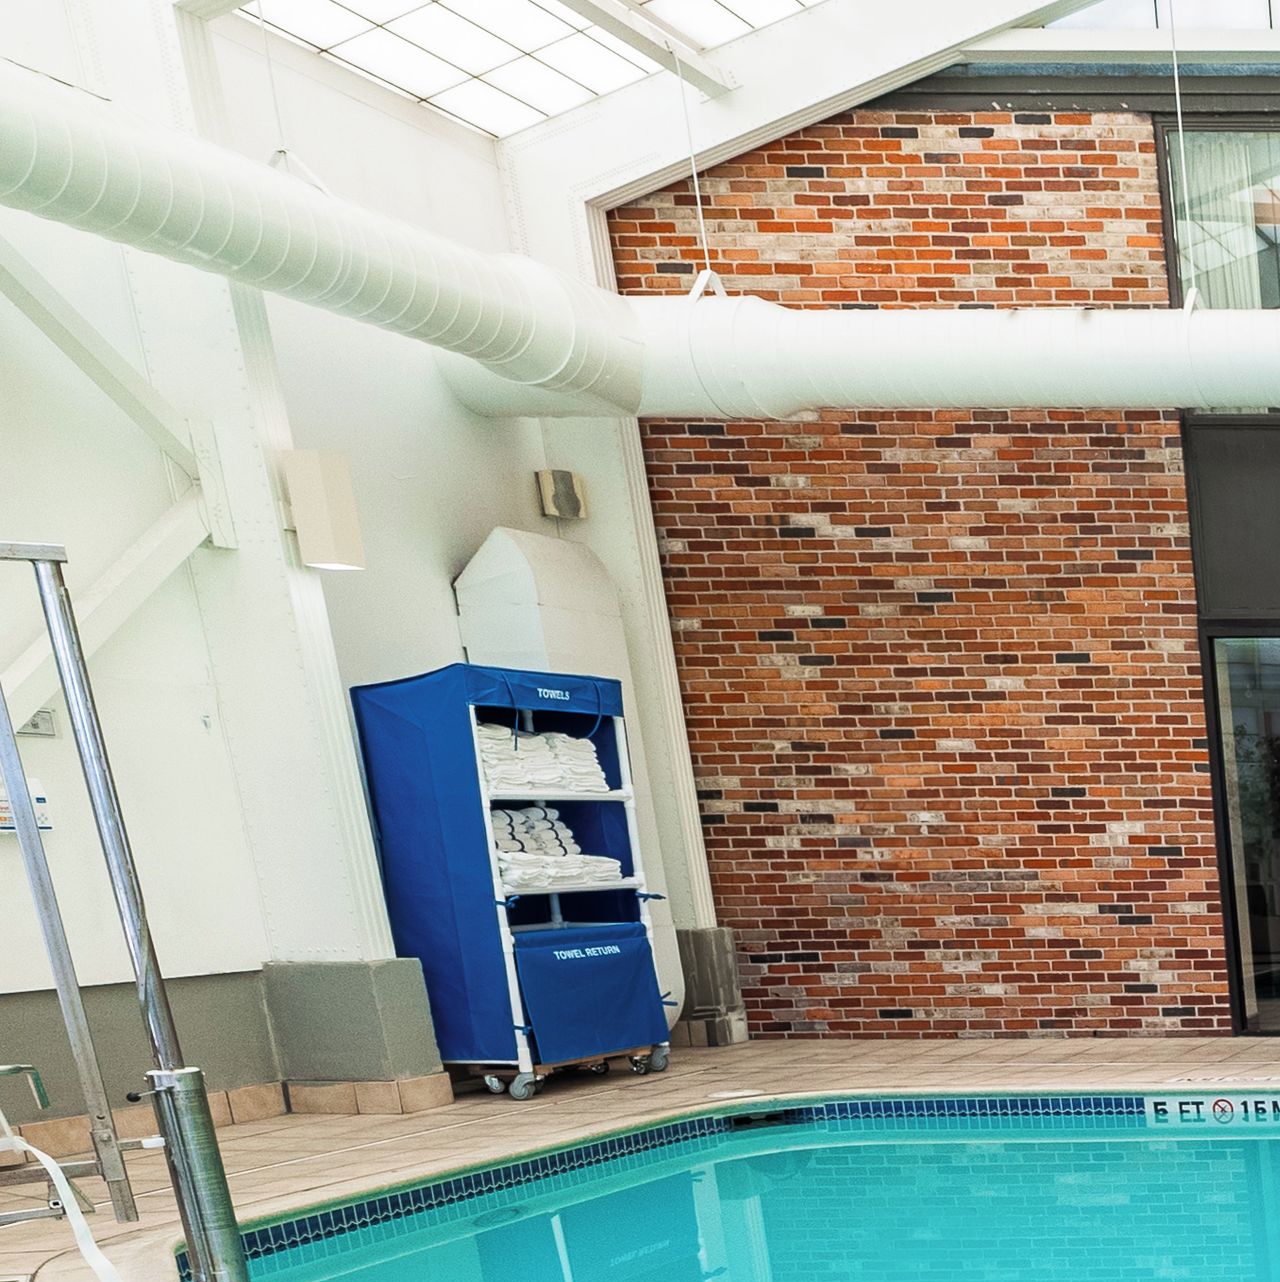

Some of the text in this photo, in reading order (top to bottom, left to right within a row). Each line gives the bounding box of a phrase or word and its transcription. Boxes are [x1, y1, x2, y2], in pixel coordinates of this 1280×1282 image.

[537, 688, 570, 701] TOWELS
[553, 944, 620, 961] TOWEL RETURN
